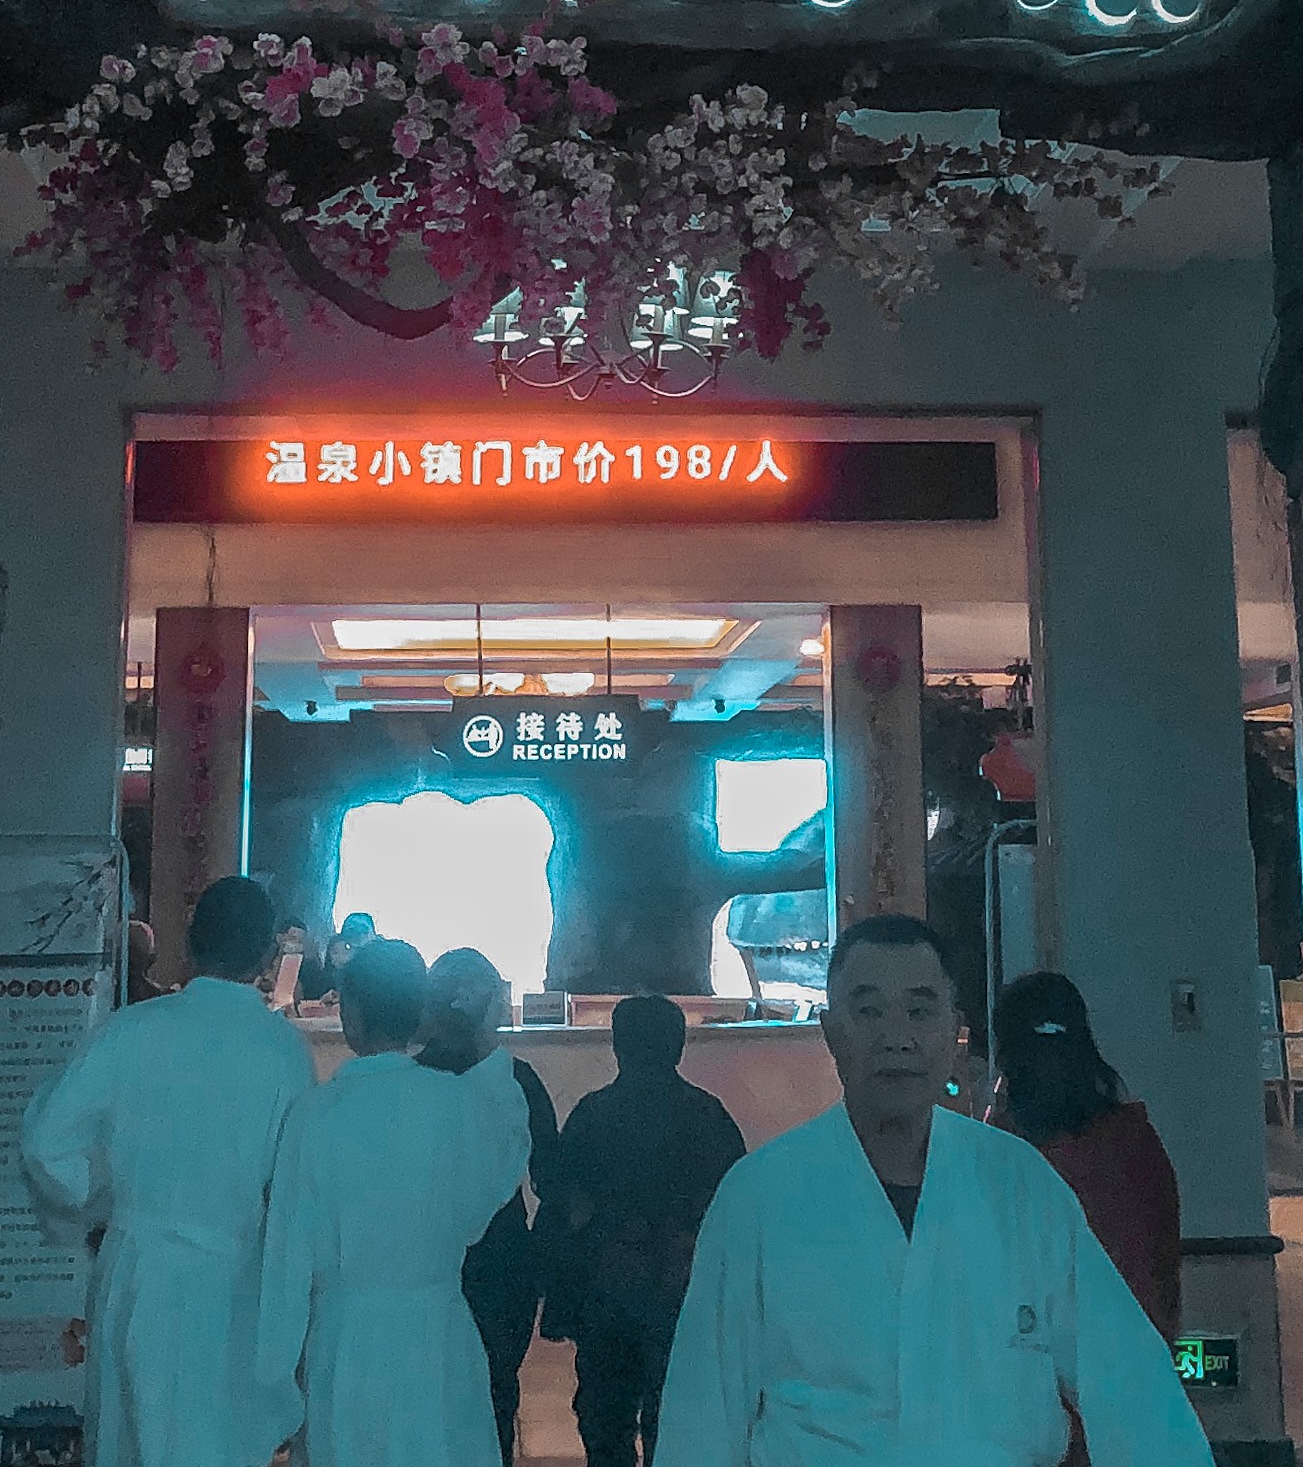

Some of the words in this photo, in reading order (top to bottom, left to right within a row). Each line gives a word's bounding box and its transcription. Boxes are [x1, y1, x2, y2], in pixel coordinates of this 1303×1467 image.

[265, 440, 789, 486] 温泉小镇门市价198/人
[516, 712, 623, 741] 接待处
[512, 743, 626, 760] RECEPTION
[1205, 1355, 1230, 1371] EXIT
